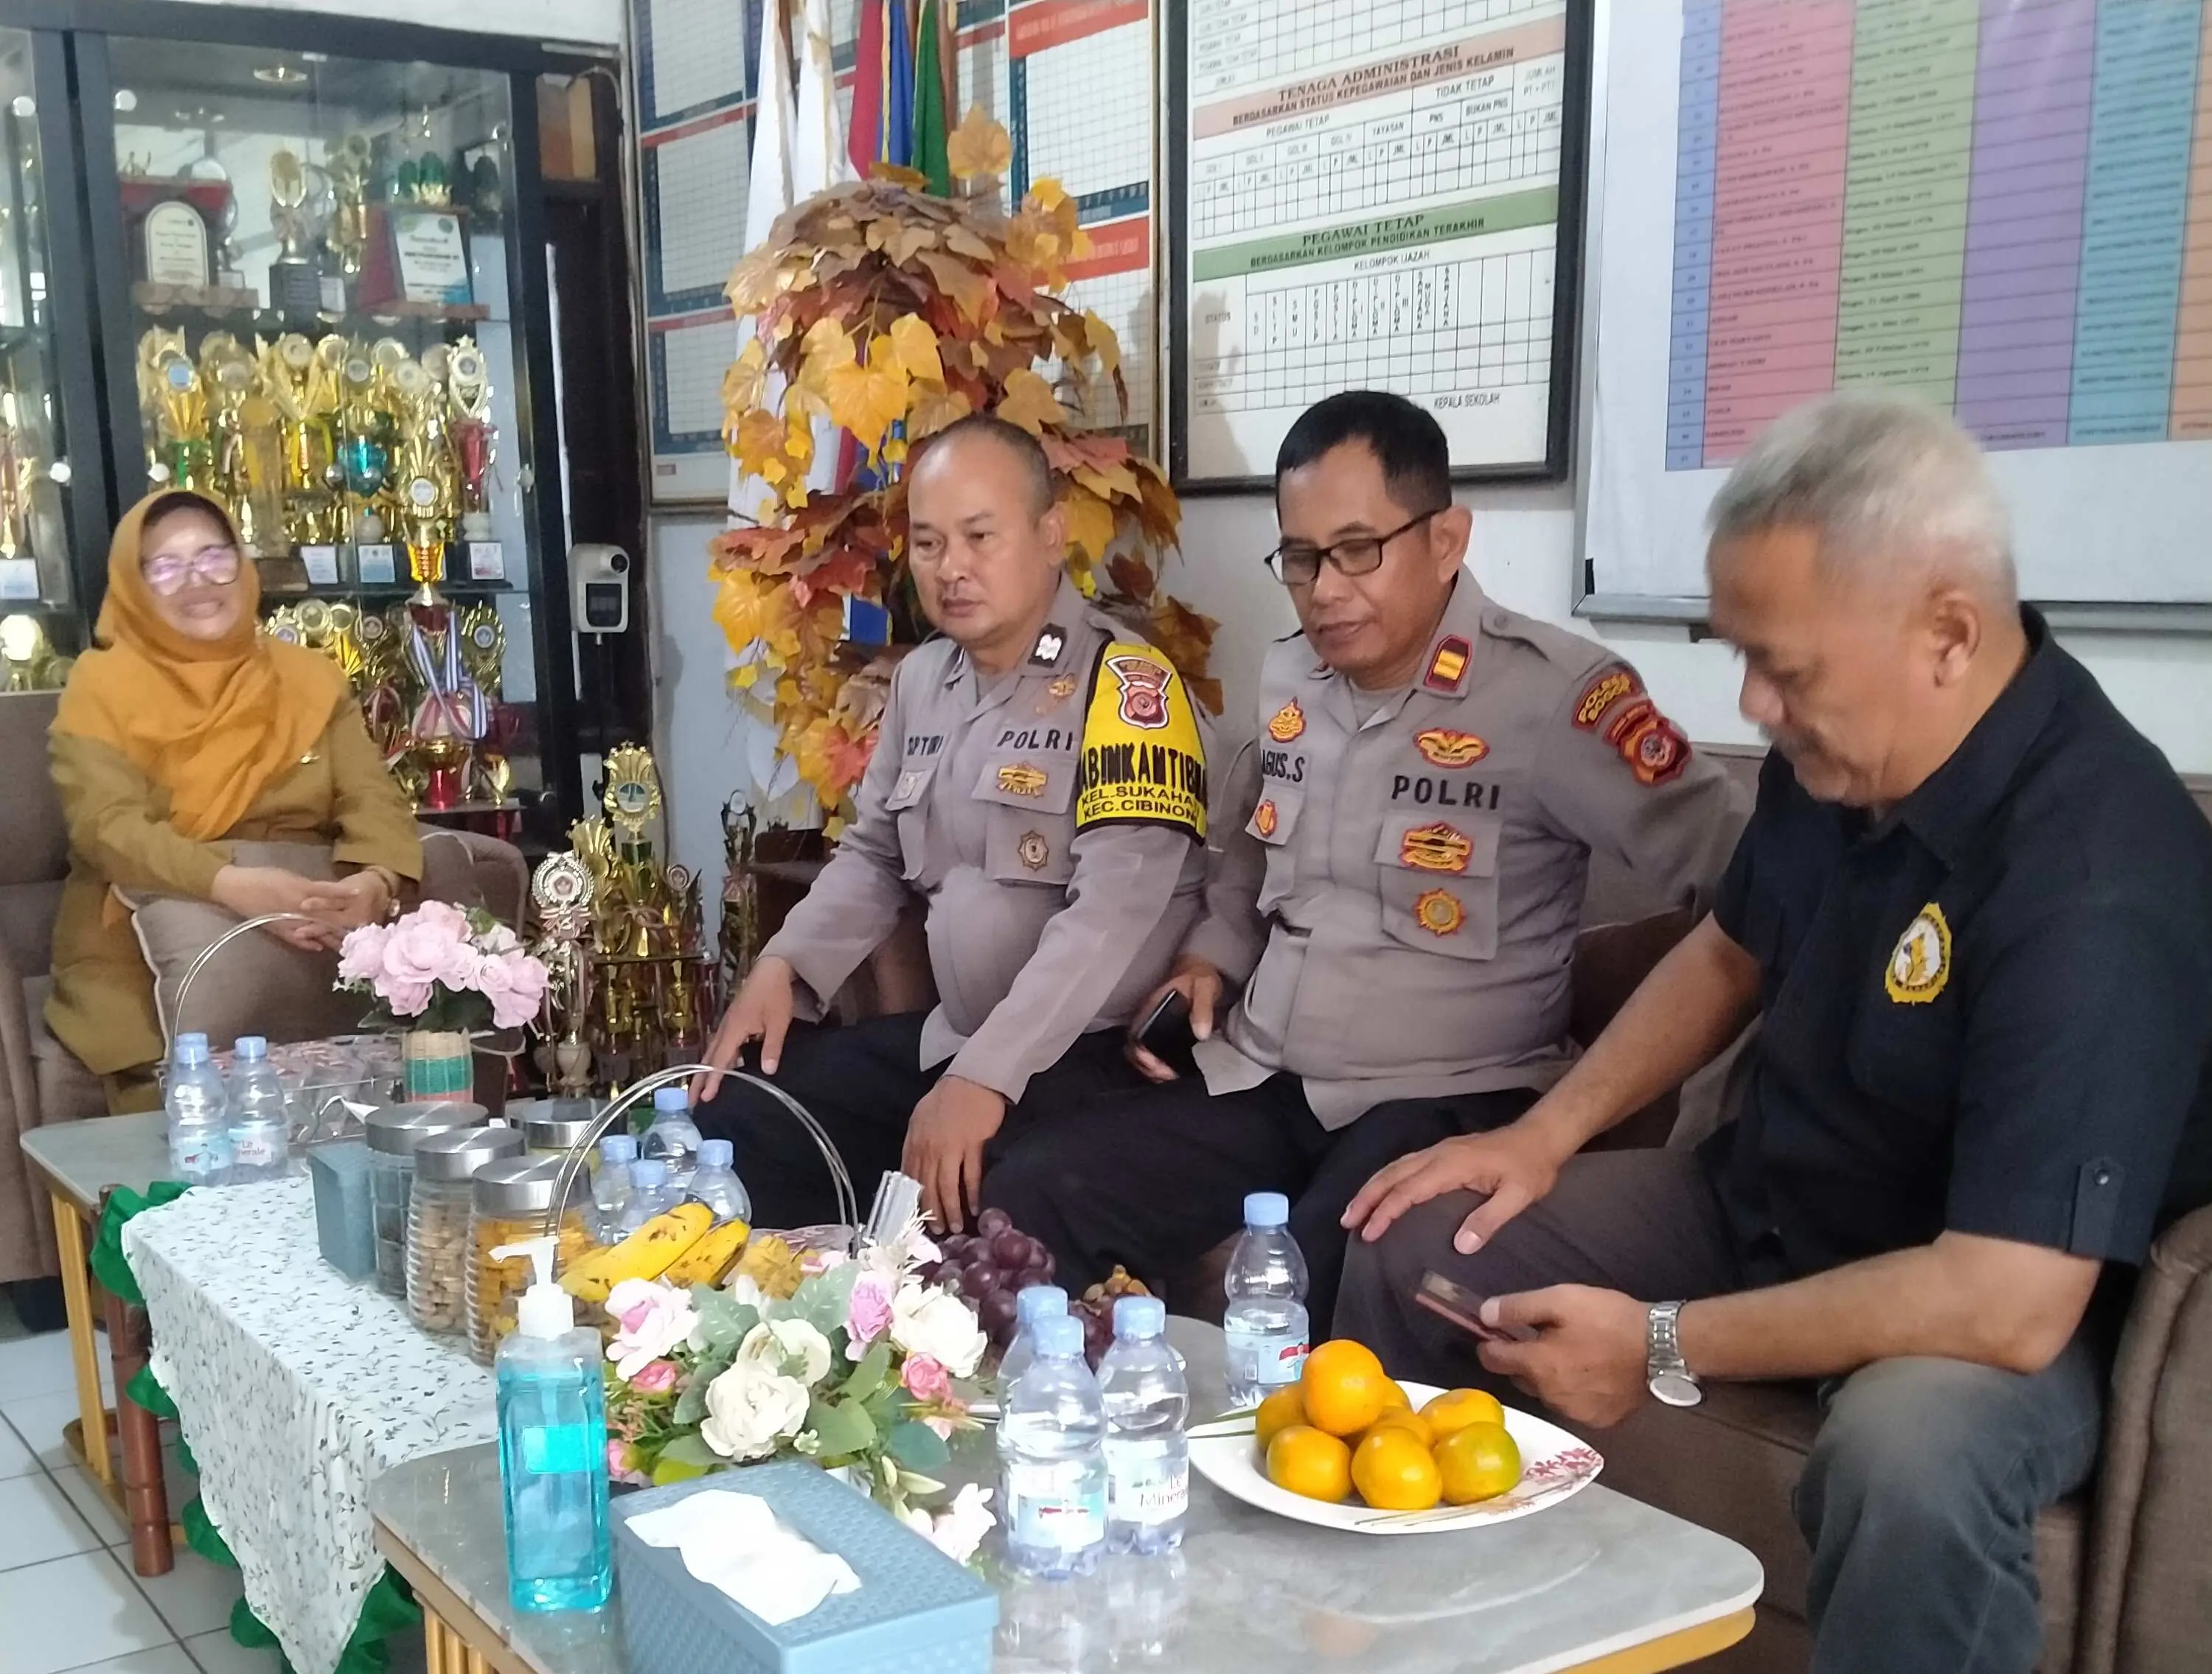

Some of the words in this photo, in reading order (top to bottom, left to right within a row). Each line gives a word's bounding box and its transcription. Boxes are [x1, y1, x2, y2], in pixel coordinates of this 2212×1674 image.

[1233, 102, 1298, 127] BERDASARKAN
[1299, 91, 1334, 111] STATUS
[1336, 74, 1407, 100] KEPEGAWAIAN
[1410, 68, 1430, 83] DAN
[1434, 60, 1463, 77] JENIS
[1466, 47, 1514, 67] KELAMIN
[1279, 77, 1337, 102] TENAGA
[1342, 46, 1459, 86] ADMINISTRASI
[1436, 83, 1462, 100] TIDAK
[1466, 74, 1495, 91] TETAP
[1251, 247, 1315, 268] BERDASARKAN
[1317, 238, 1367, 257] KELOMPOK
[1371, 229, 1430, 247] PENDIDIKAN
[1434, 217, 1485, 236] TERAKHIR
[1303, 223, 1368, 246] PEGAWAI
[1375, 214, 1425, 233] TETAP
[1353, 254, 1399, 271] KELOMPOK
[996, 728, 1074, 751] POLRI
[1391, 775, 1501, 810] POLRI
